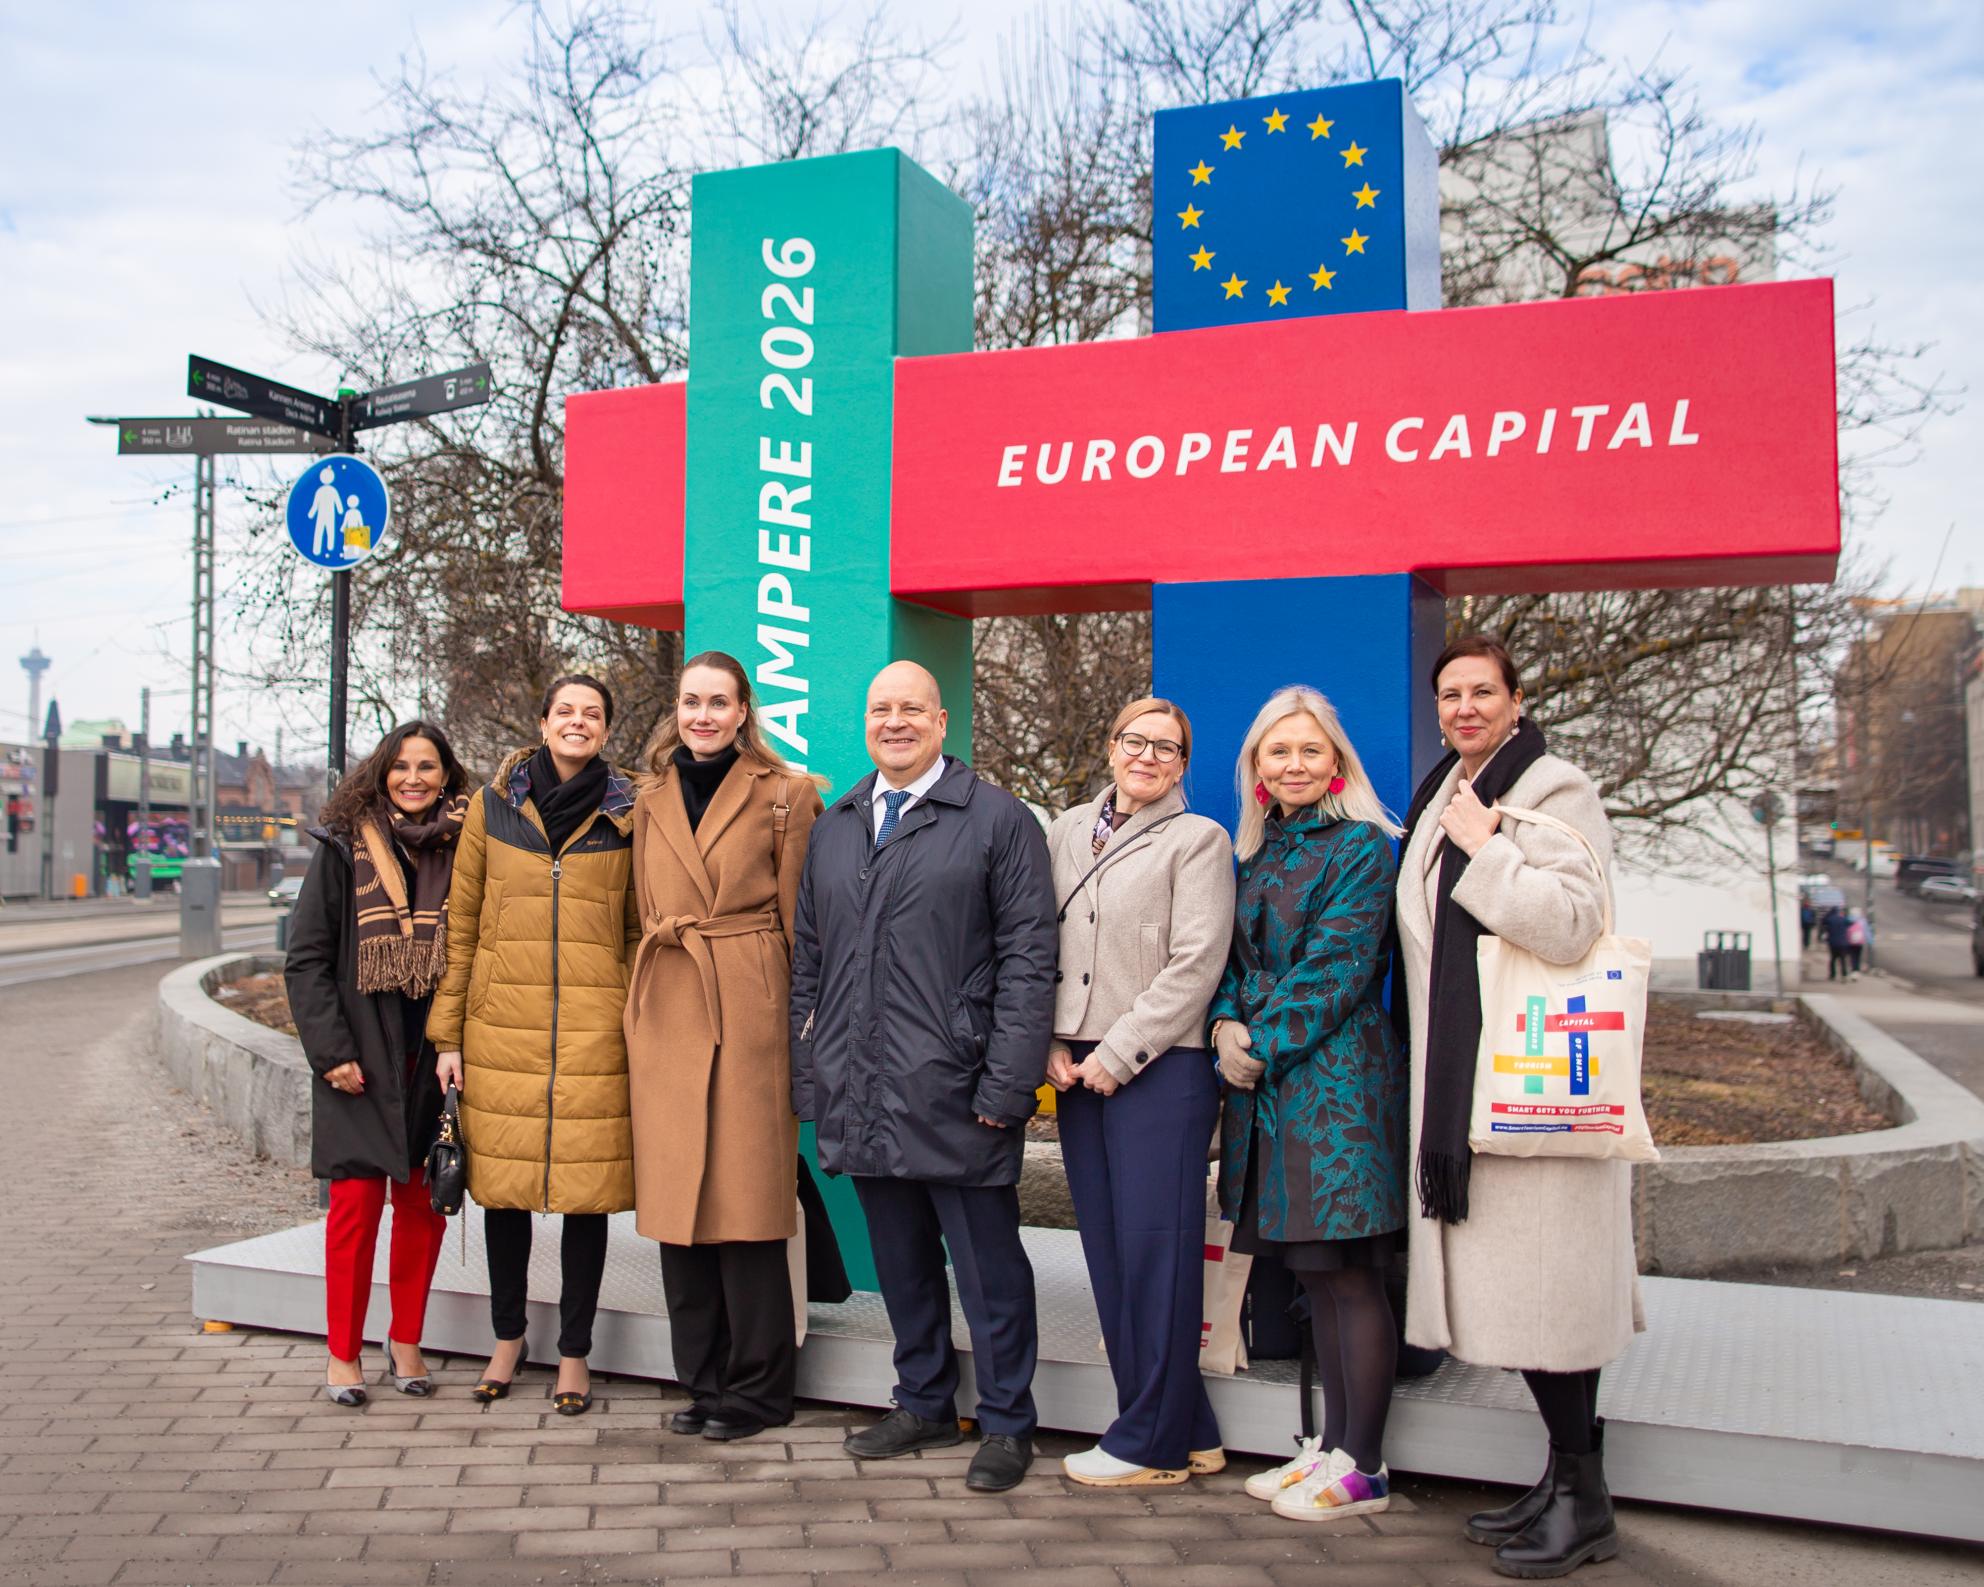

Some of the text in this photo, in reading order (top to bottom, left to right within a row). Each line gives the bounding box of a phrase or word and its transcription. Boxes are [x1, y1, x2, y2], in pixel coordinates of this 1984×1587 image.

[262, 425, 296, 435] stadion
[264, 438, 295, 446] Stadium
[997, 399, 1701, 487] EUROPEAN CAPITAL
[755, 237, 817, 773] AMPERE 2026
[1558, 1018, 1595, 1027] CAPITAL
[1574, 1037, 1583, 1083] OF SMART
[1513, 1062, 1553, 1070] TOURISM
[1507, 1105, 1534, 1114] SMART
[1559, 1107, 1576, 1115] YOU
[1578, 1105, 1611, 1115] FURTHER
